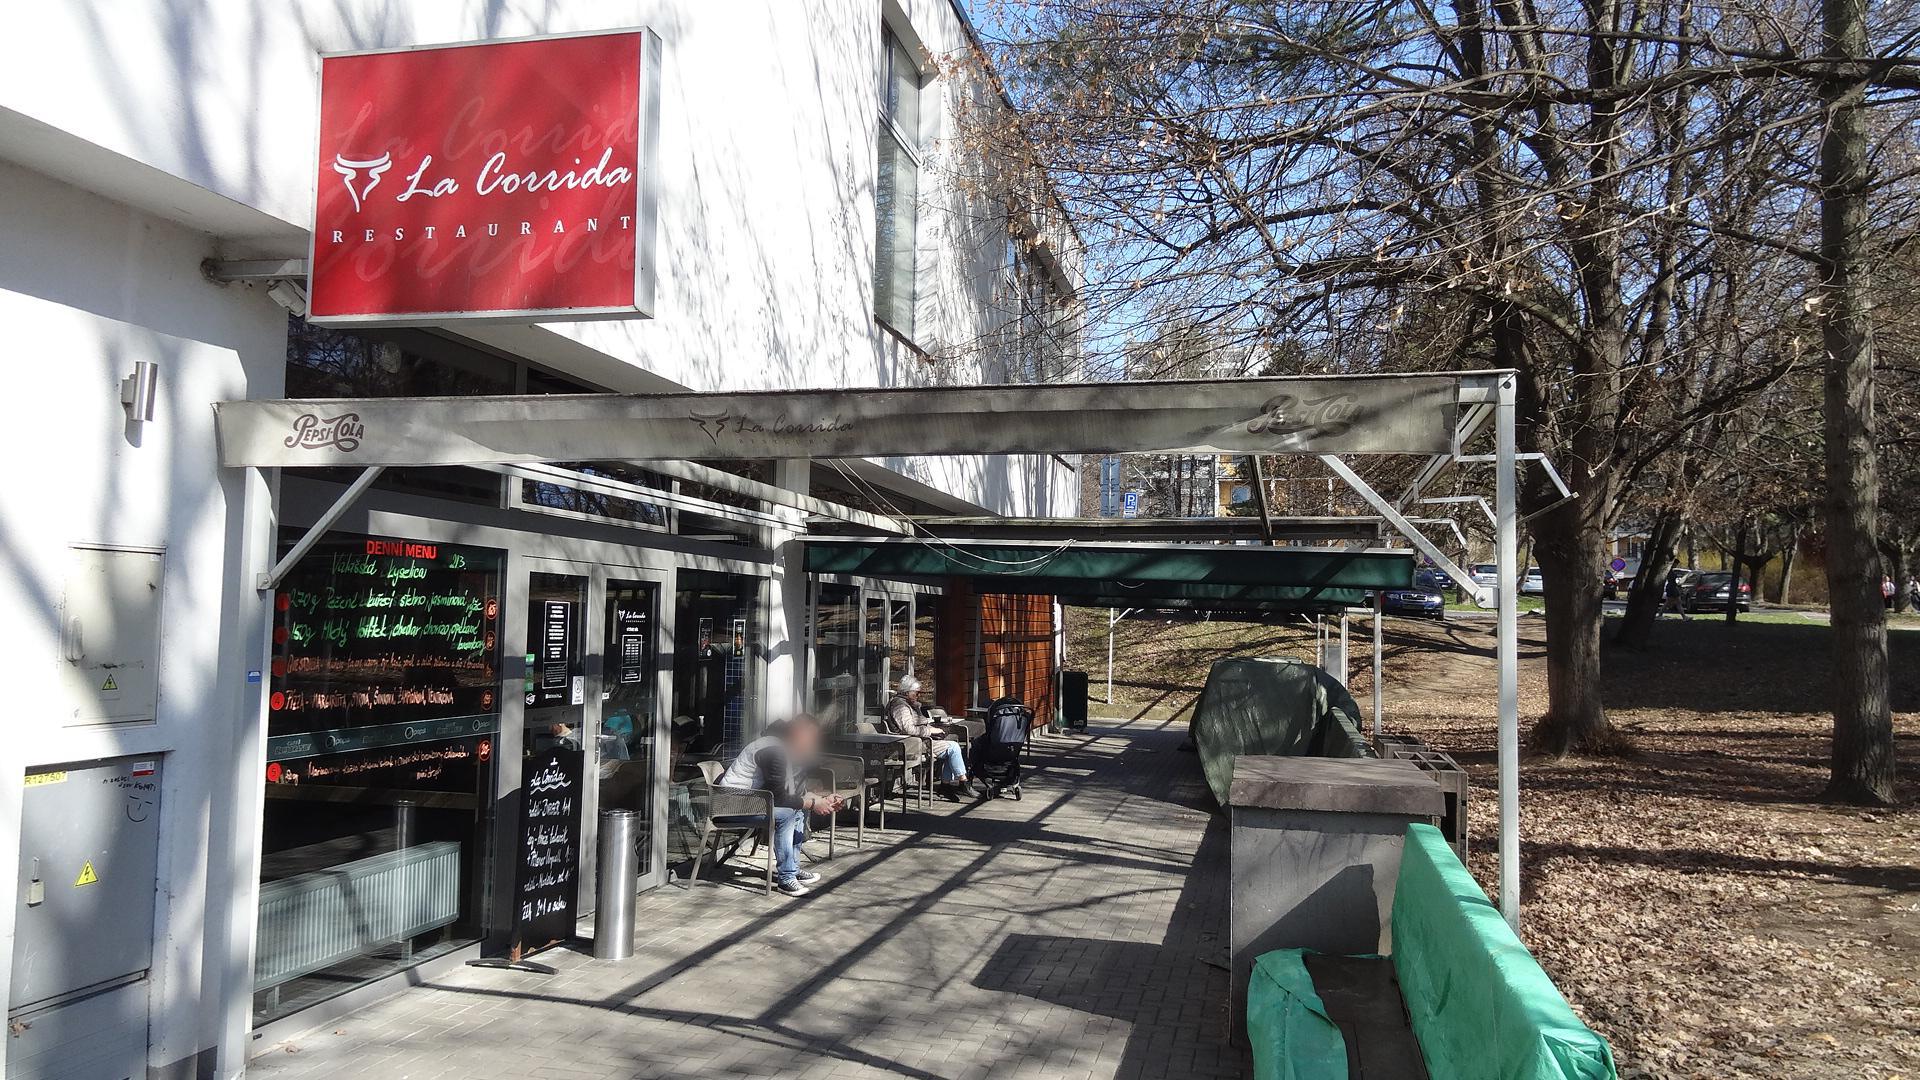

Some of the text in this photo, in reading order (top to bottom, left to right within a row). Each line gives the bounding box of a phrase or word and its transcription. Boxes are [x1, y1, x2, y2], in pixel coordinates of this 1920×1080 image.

[396, 147, 632, 202] La Corrida
[332, 215, 631, 243] RESTAURANT
[735, 414, 855, 434] La Corrida
[366, 539, 438, 560] DENNÍ MENU
